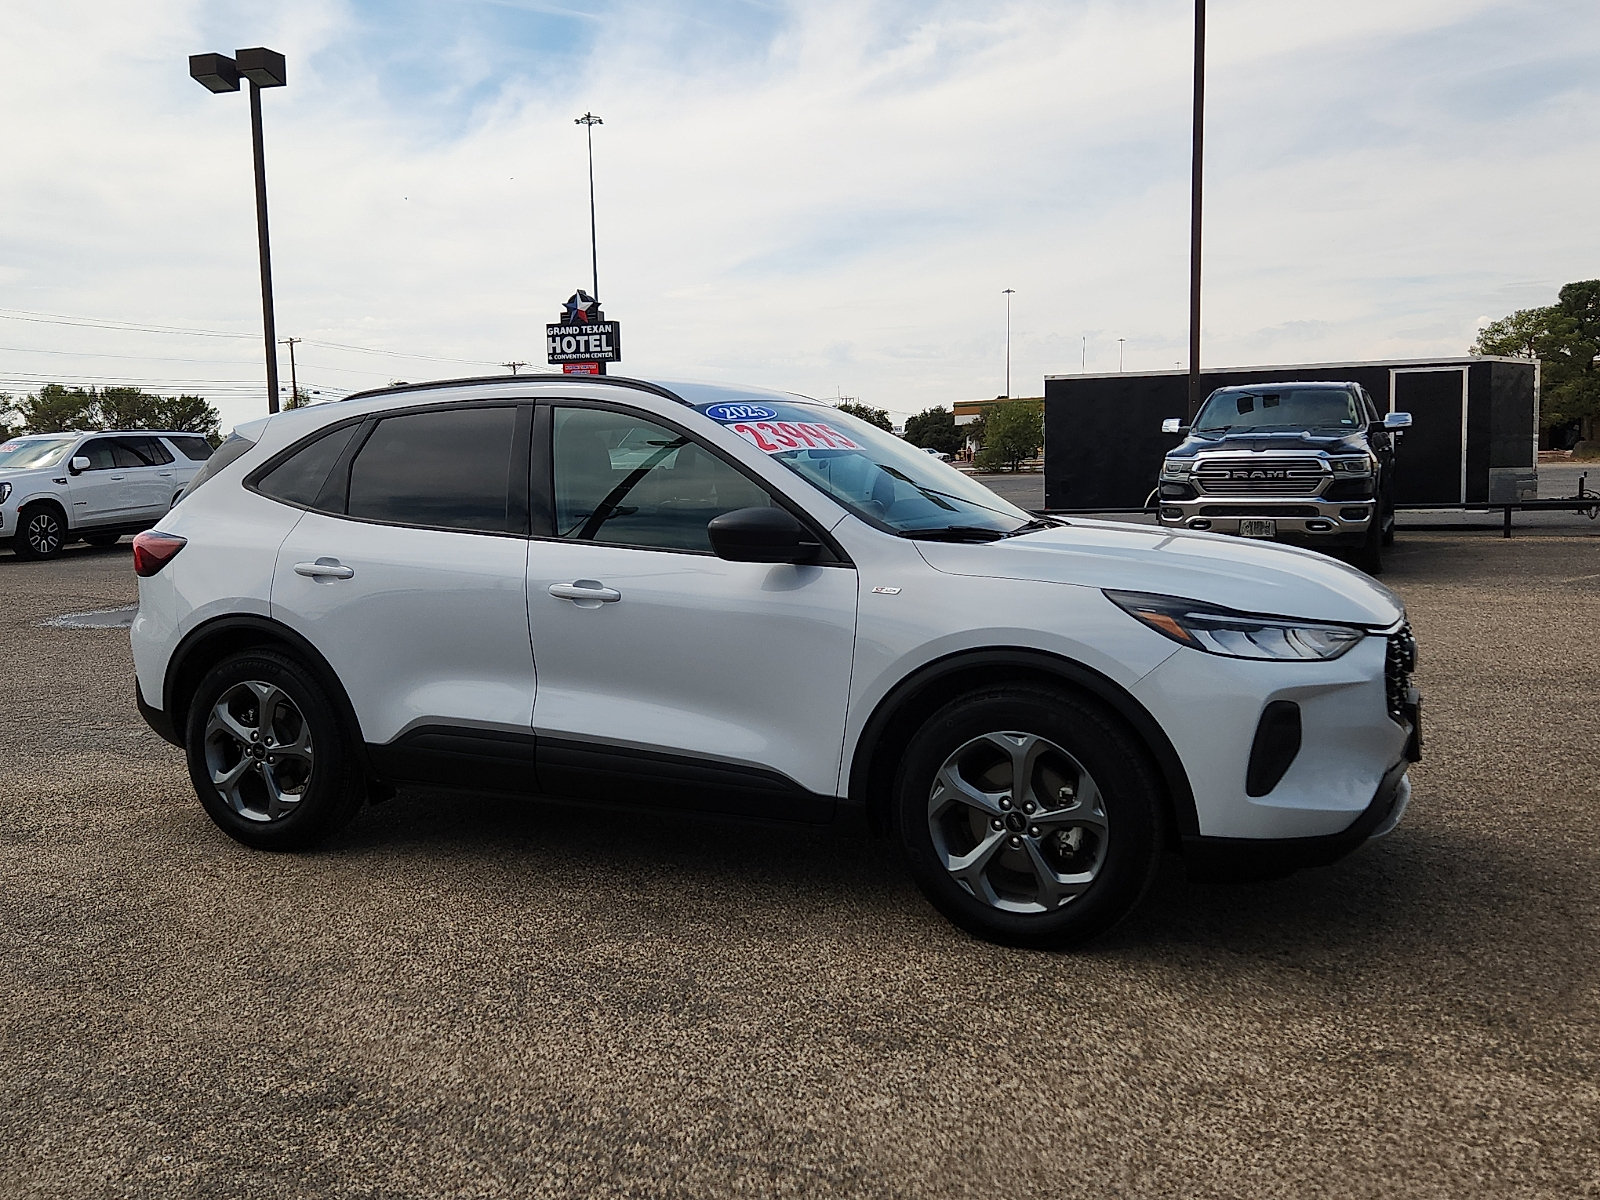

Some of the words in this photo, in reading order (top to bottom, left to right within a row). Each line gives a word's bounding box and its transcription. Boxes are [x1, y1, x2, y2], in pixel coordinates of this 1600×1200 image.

[547, 327, 579, 335] GRAND
[581, 325, 612, 333] TEXAN
[547, 335, 613, 353] HOTEL
[719, 405, 769, 419] 2025
[735, 423, 858, 451] 23995
